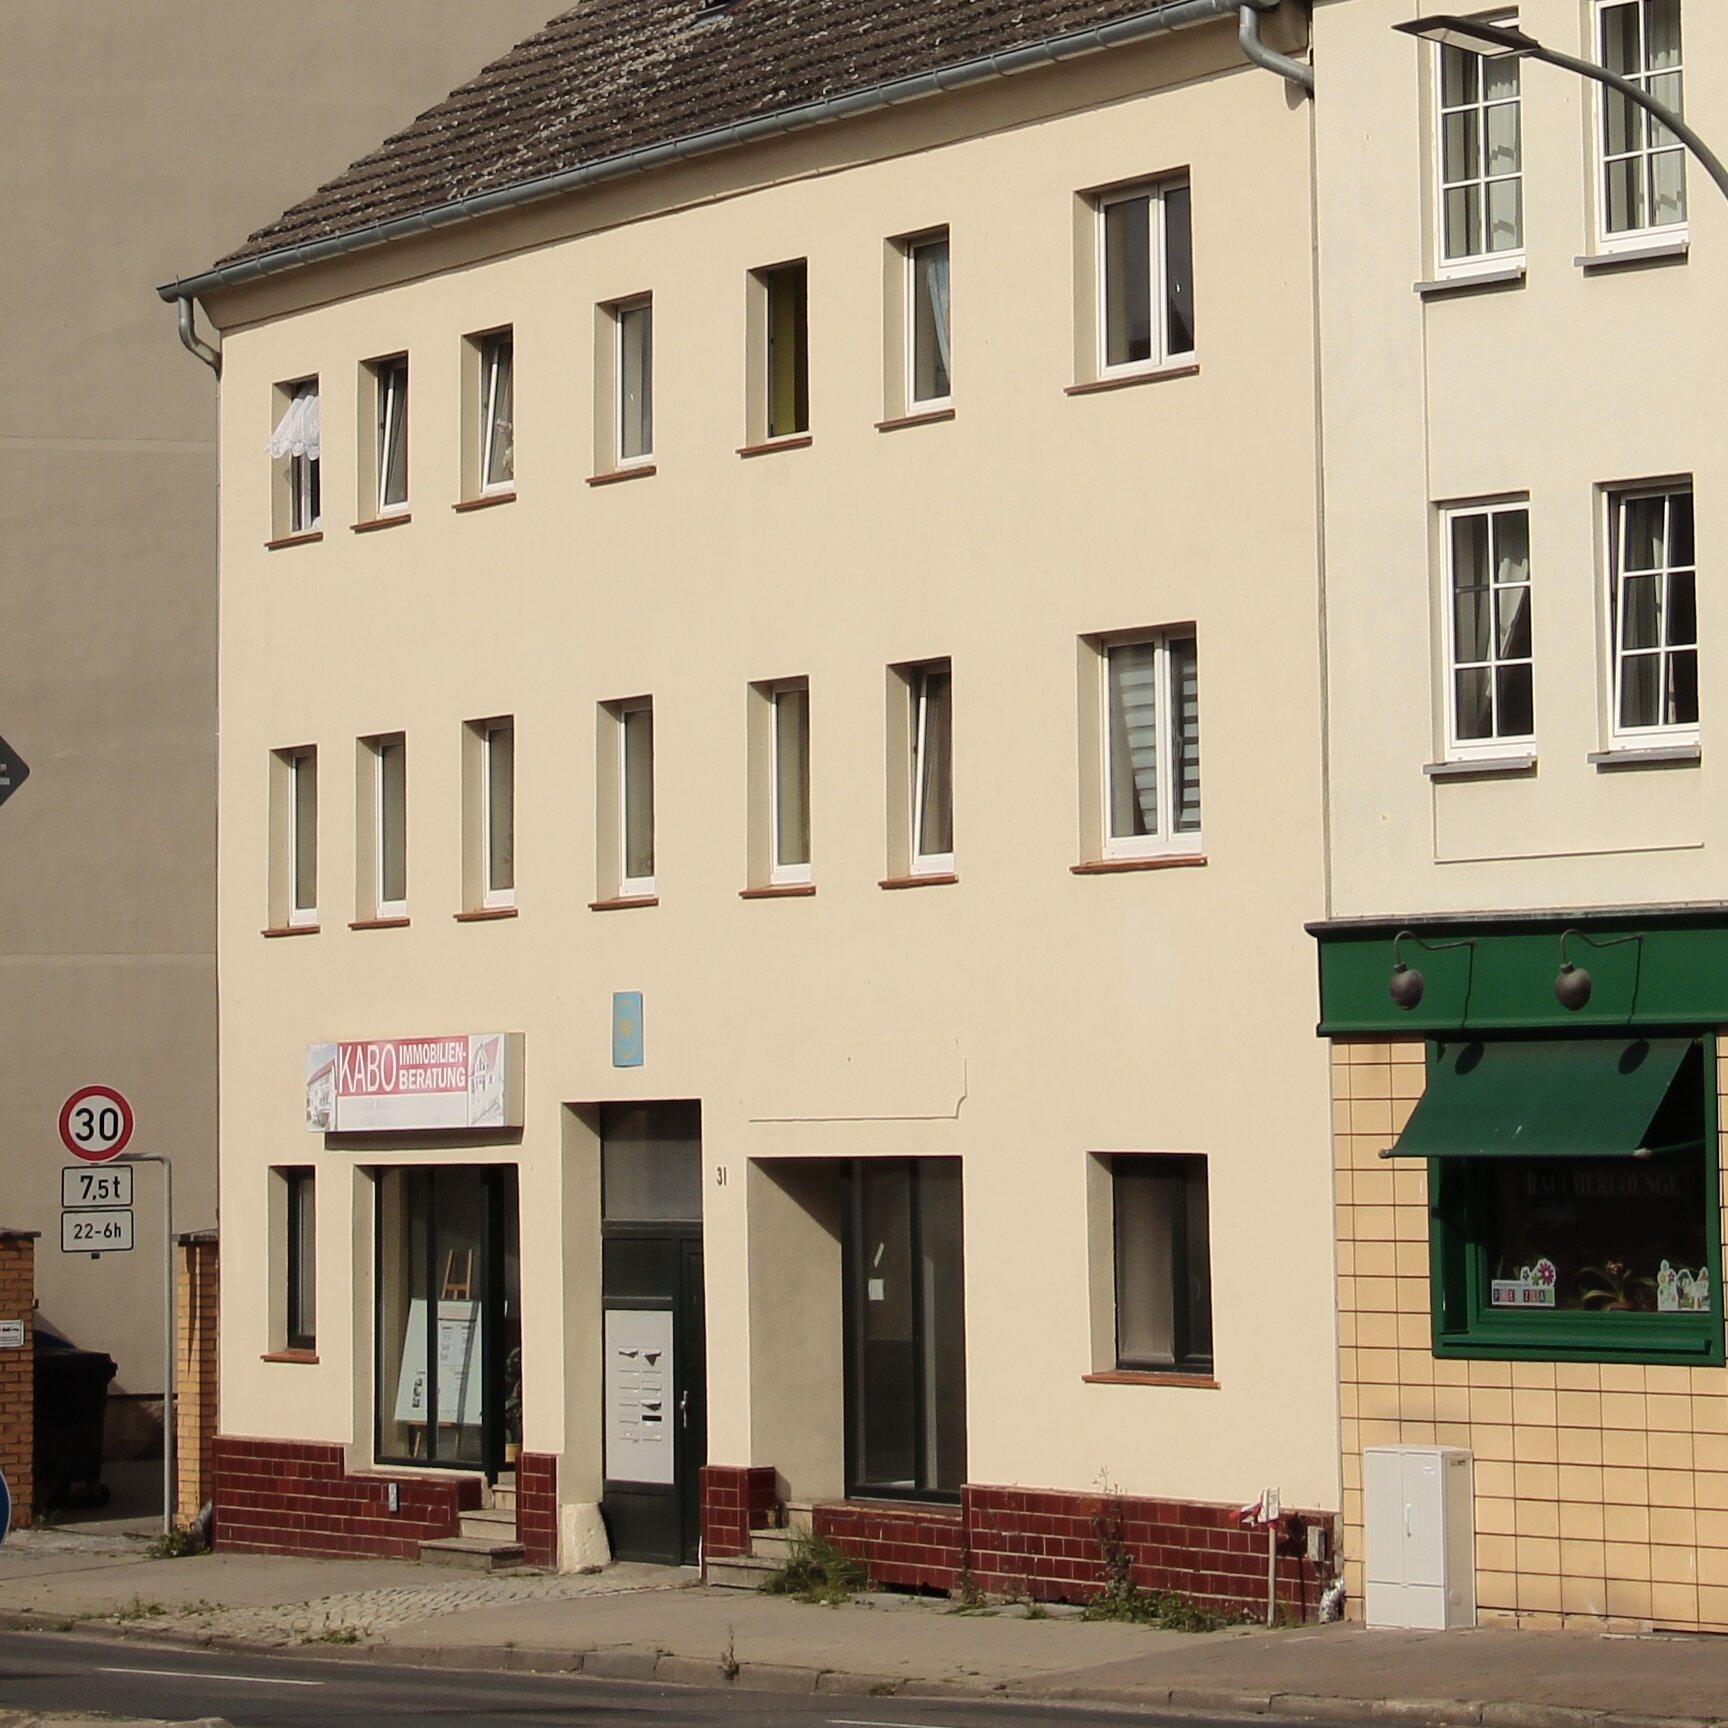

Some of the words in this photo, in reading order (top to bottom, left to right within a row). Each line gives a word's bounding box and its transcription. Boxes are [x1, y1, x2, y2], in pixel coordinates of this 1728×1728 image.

[399, 1041, 467, 1066] IMMOBILIEN-
[338, 1043, 397, 1093] KABO
[399, 1066, 467, 1090] BERATUNG
[74, 1107, 119, 1141] 30
[716, 1166, 727, 1187] 31
[73, 1222, 122, 1240] 22-6h
